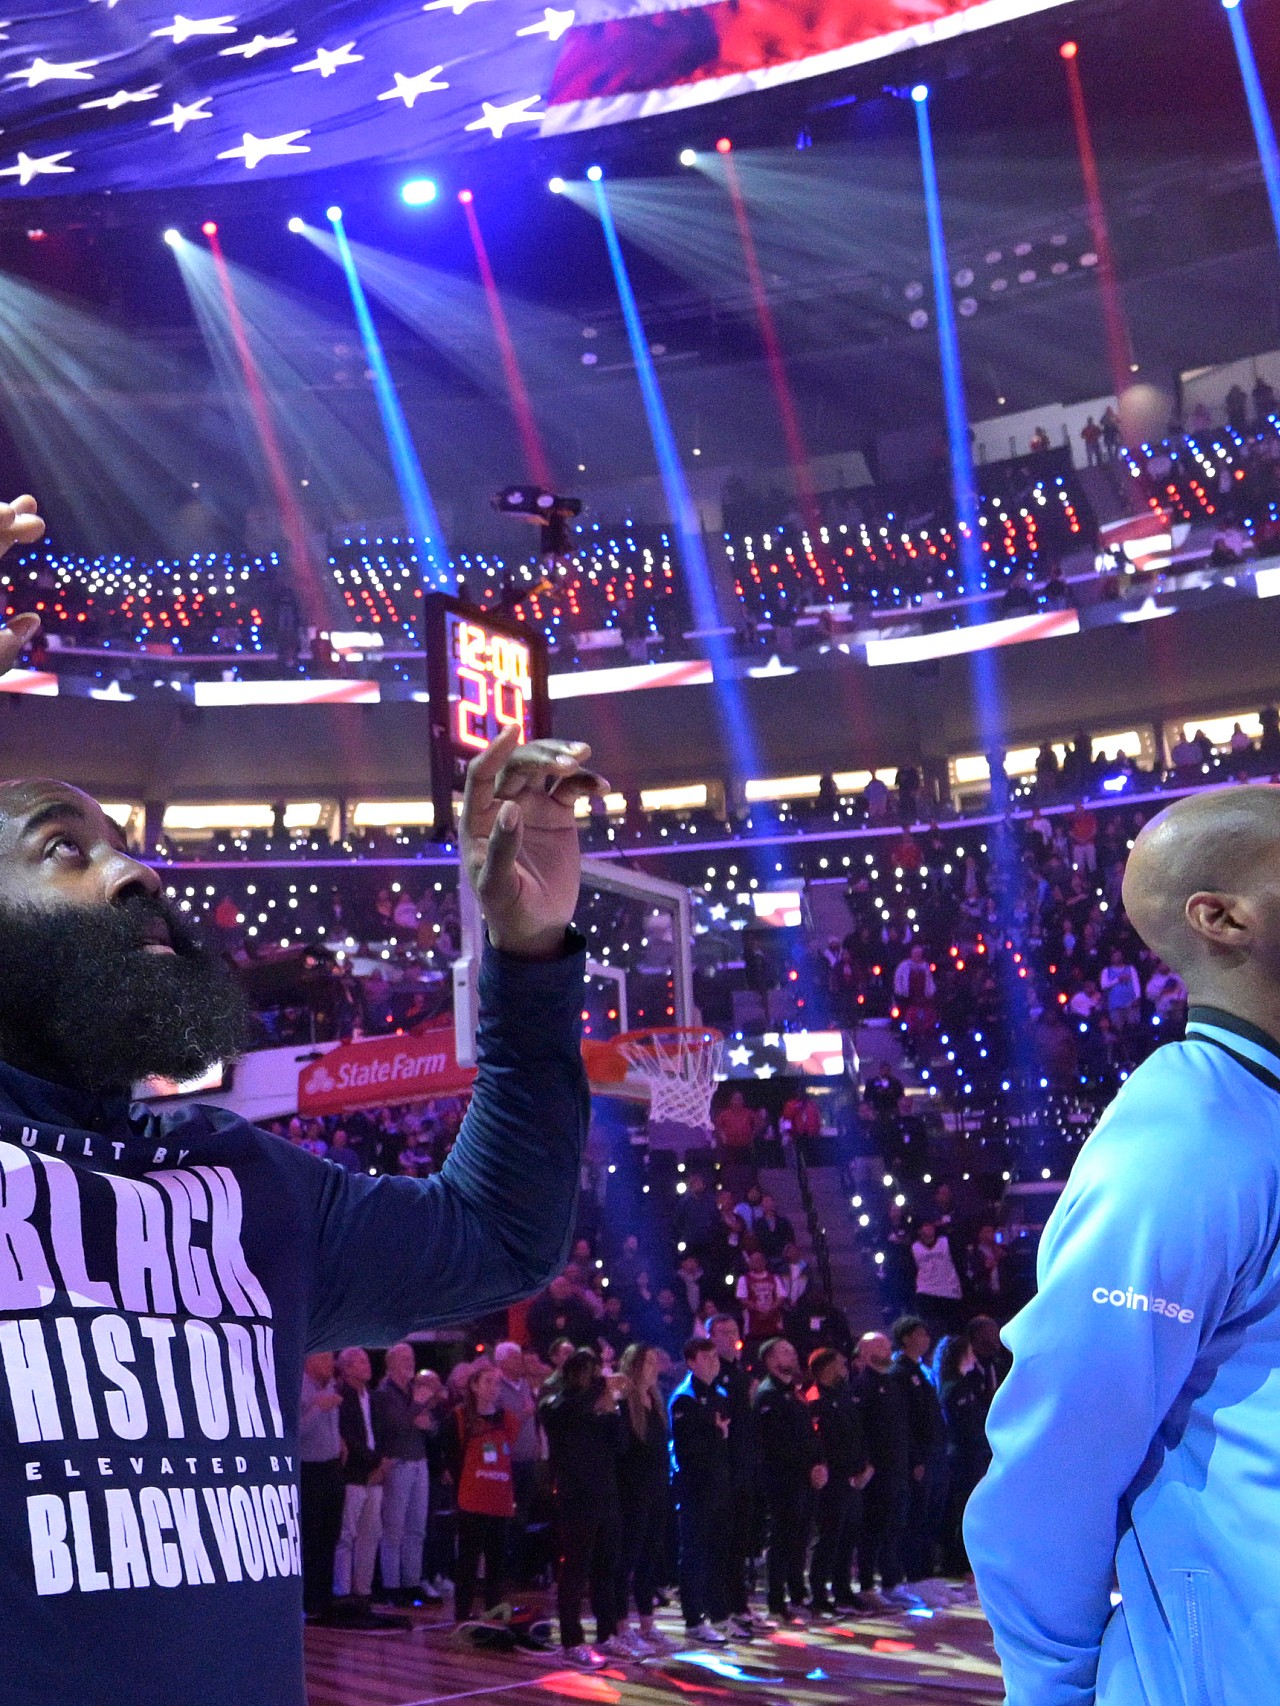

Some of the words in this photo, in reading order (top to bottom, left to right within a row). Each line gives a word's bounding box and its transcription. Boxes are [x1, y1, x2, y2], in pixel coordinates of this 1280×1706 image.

[459, 621, 529, 687] 12:00
[152, 1147, 189, 1166] BY
[1092, 1287, 1195, 1323] coinase
[26, 1456, 247, 1481] ELEVATED
[270, 1456, 293, 1472] BY
[26, 1487, 215, 1596] BLACK
